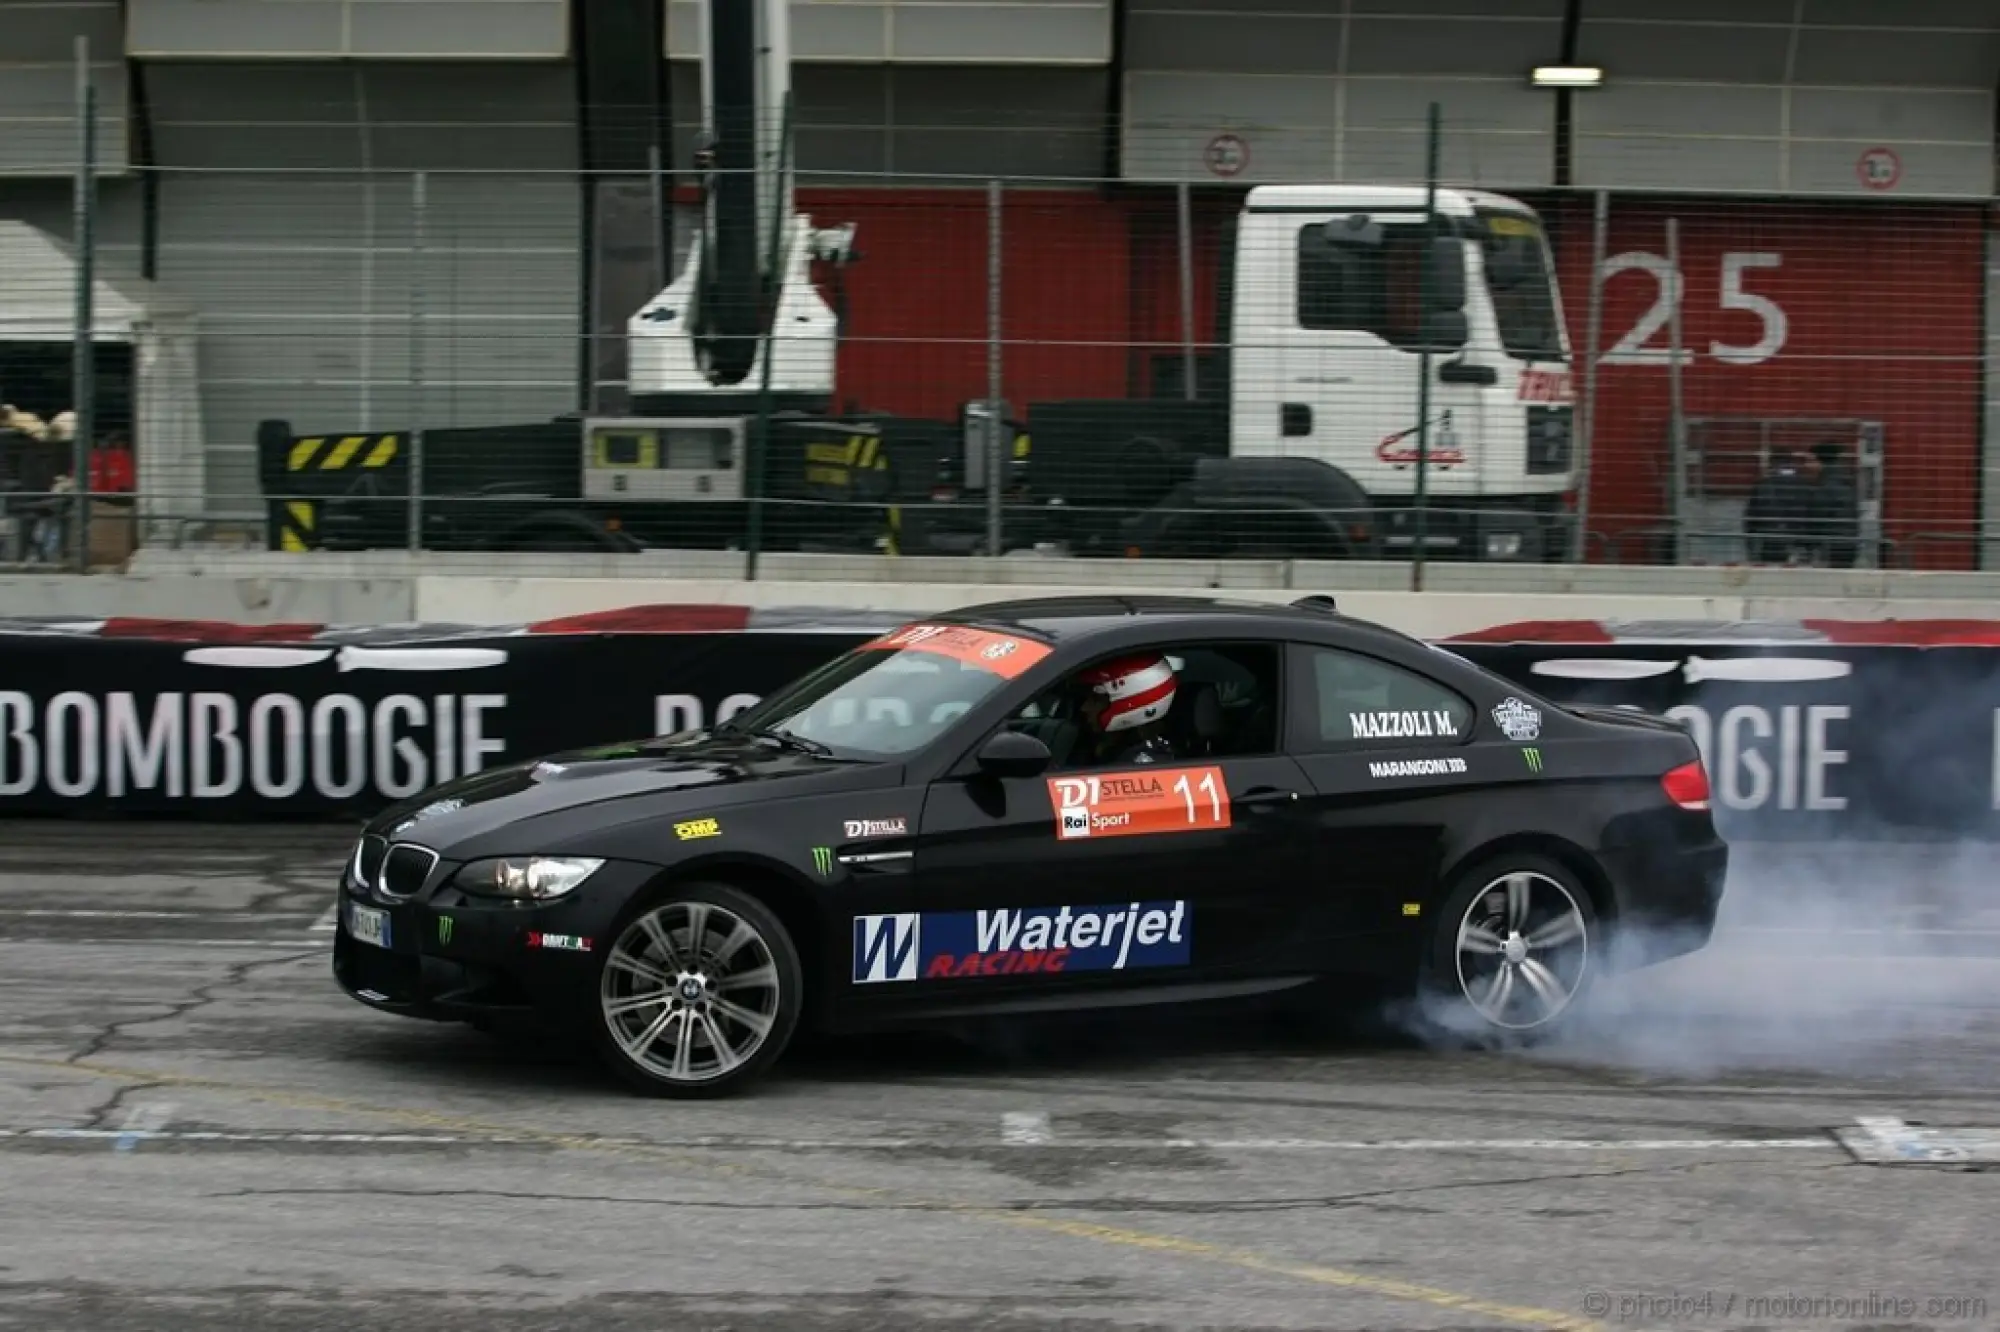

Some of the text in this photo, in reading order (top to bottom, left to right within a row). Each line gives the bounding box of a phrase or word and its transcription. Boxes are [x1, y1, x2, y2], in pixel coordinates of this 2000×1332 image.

[1596, 252, 1788, 364] 25
[0, 691, 508, 799] BOMBOOGIE
[1349, 710, 1458, 739] MAZZOLI M.
[1368, 758, 1447, 778] MARANGONI
[1101, 777, 1163, 796] STELLA
[1173, 771, 1221, 823] 11
[1063, 811, 1130, 831] Rai Sport
[975, 900, 1185, 969] Waterjet
[926, 948, 1069, 978] RACING
